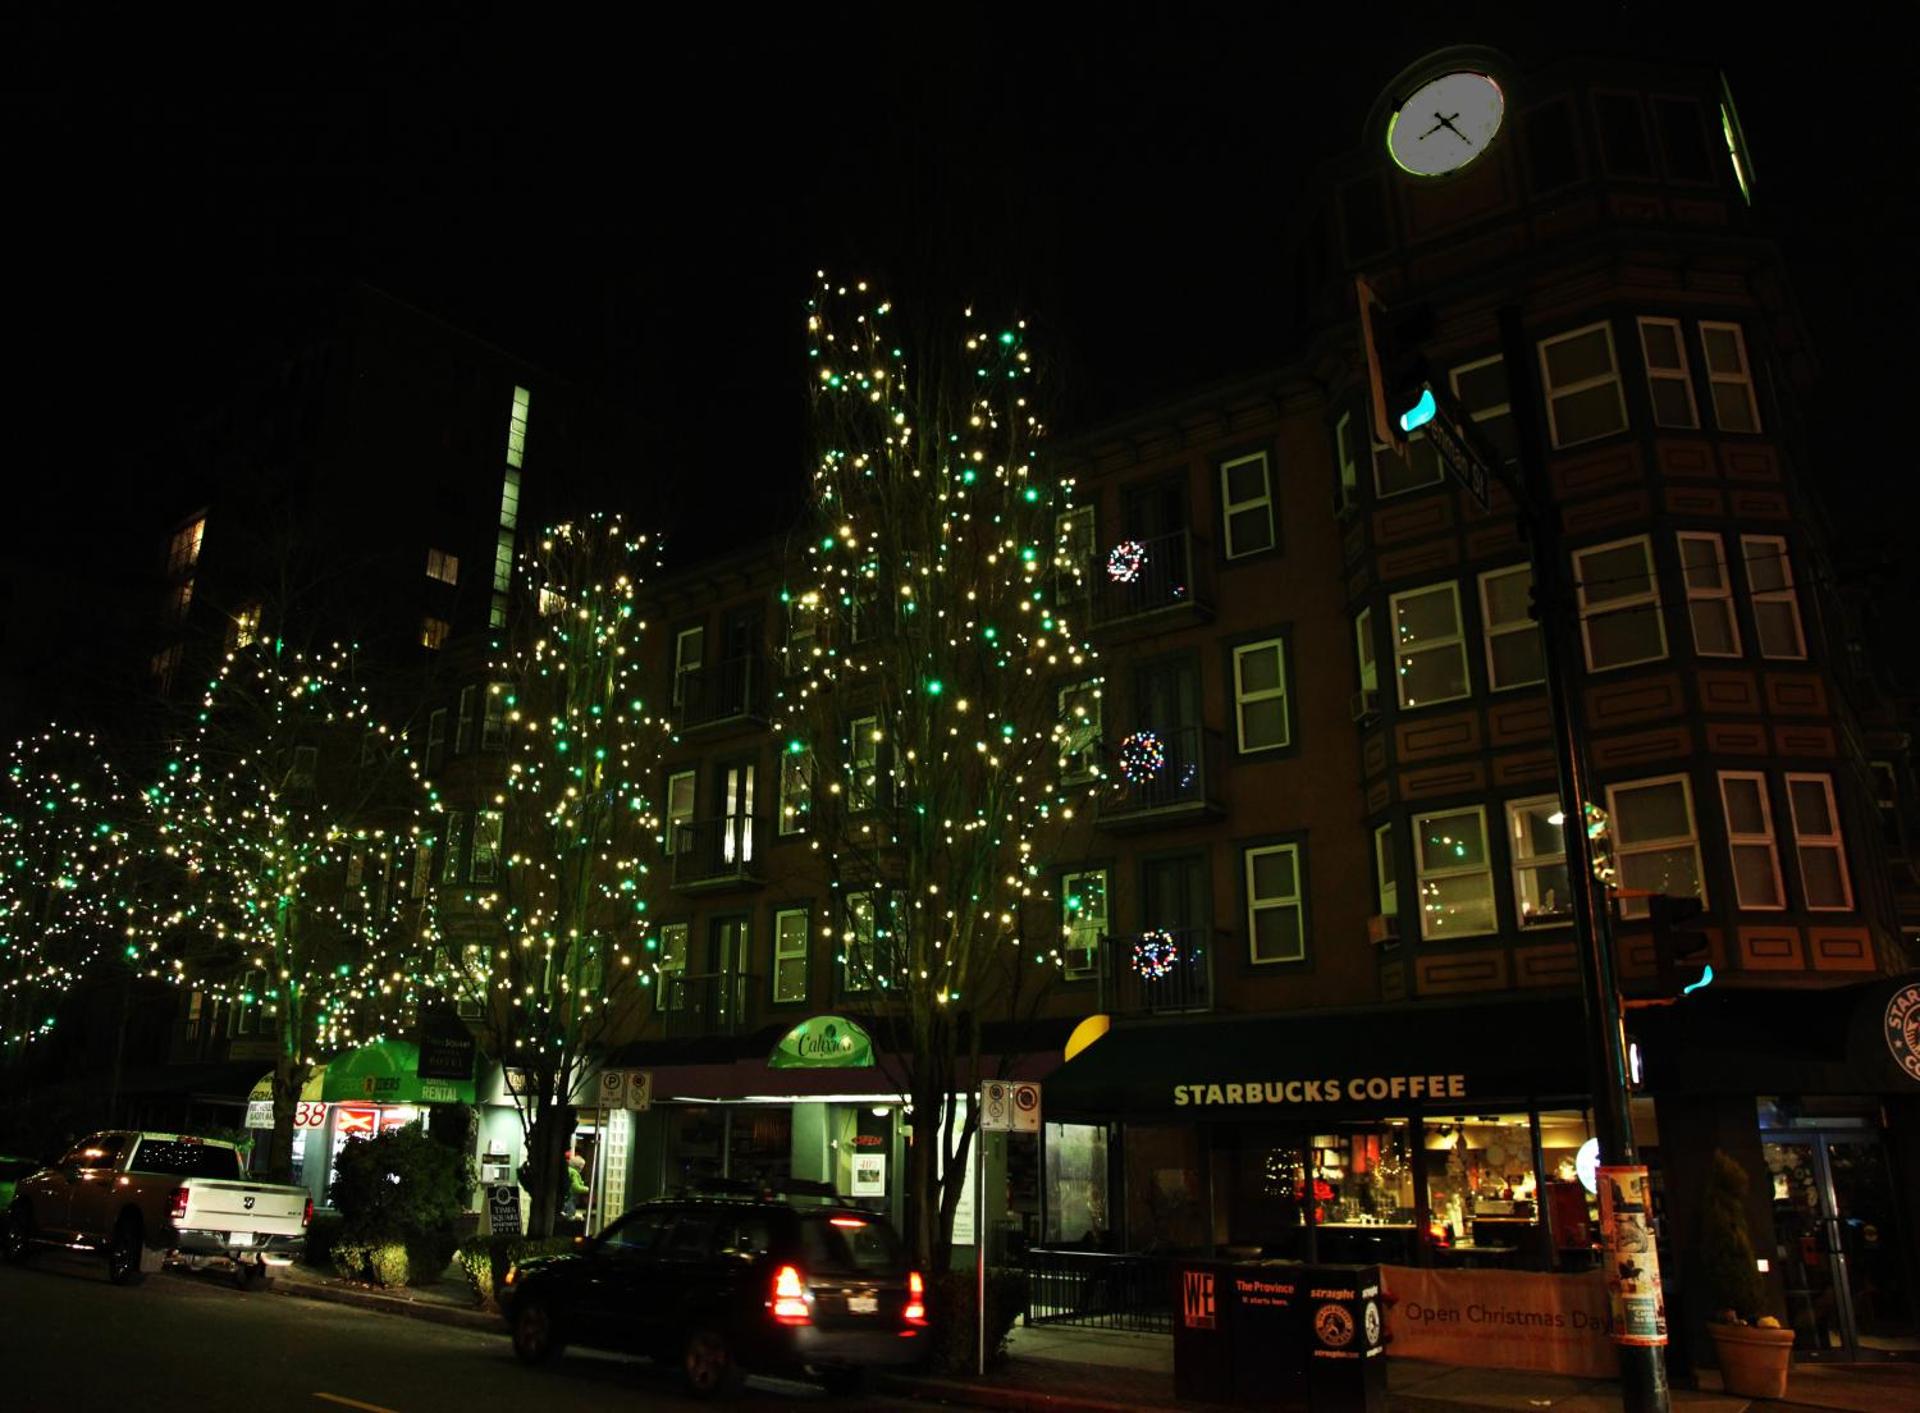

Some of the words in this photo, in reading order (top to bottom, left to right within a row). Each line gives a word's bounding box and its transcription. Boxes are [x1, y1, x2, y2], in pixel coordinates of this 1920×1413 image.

[421, 1086, 458, 1101] RENTAL
[1173, 1079, 1342, 1107] STARBUCKS
[1347, 1075, 1466, 1100] COFFEE
[1236, 1280, 1253, 1292] The
[1254, 1281, 1295, 1294] Province
[1405, 1302, 1460, 1326] Open
[1466, 1304, 1565, 1328] Christmas
